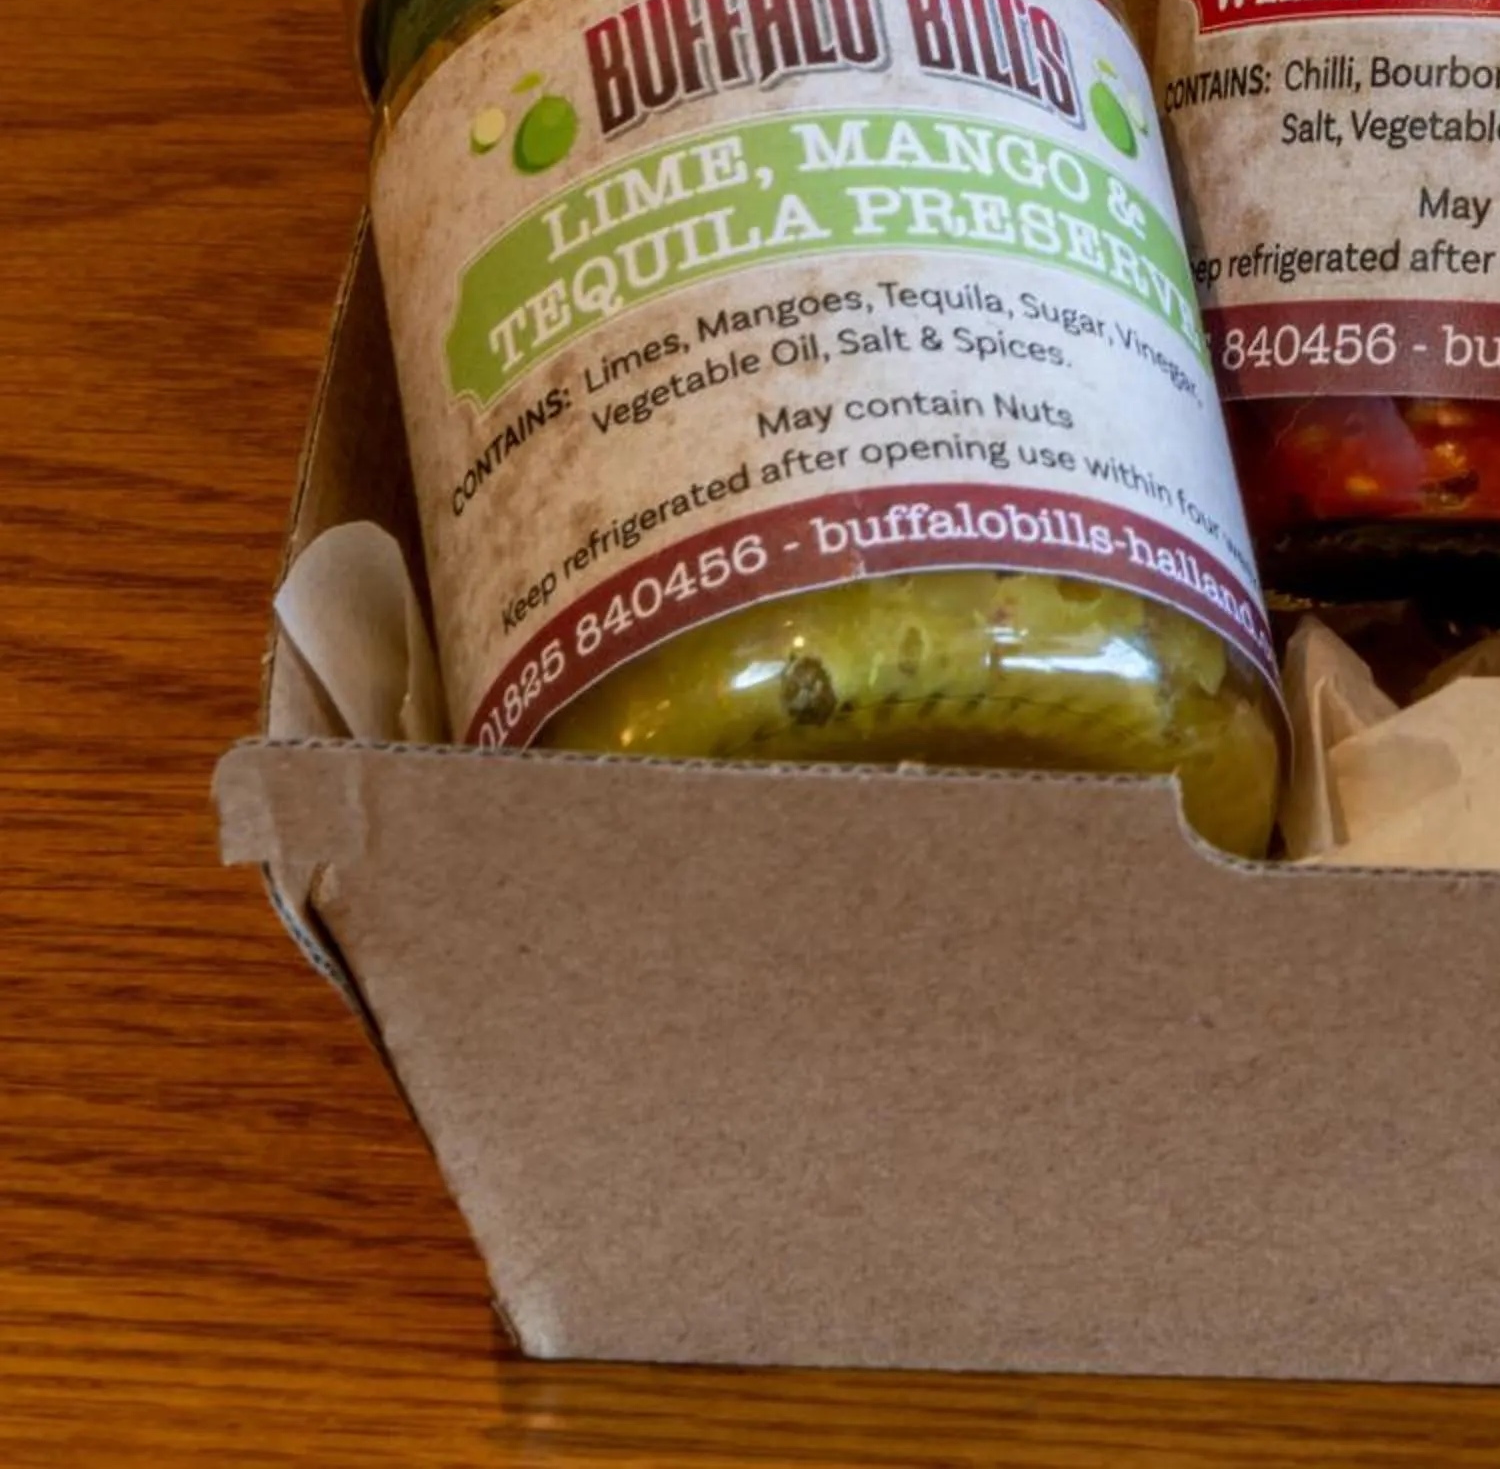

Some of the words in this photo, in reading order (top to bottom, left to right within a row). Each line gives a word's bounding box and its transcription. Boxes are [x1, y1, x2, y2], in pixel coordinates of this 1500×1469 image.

[1164, 64, 1272, 113] CONTAINS:
[1284, 57, 1363, 94] Chilli,
[1282, 112, 1345, 146] Salt,
[539, 136, 773, 263] LIME,
[792, 122, 1087, 201] MANGO
[1106, 177, 1147, 238] &
[1419, 187, 1491, 227] May
[489, 194, 831, 373] TEQUILA
[1227, 240, 1400, 283] refrigerated
[1409, 240, 1496, 276] after
[591, 349, 761, 434] Vegetable
[771, 330, 830, 367] Oil,
[837, 323, 910, 362] Salt
[919, 325, 943, 351] &
[953, 325, 1072, 367] Spices.
[1222, 323, 1397, 371] 840456
[451, 388, 572, 517] CONTAINS:
[584, 332, 690, 392] Limes,
[697, 286, 875, 341] Mangoes,
[877, 281, 1013, 320] Tequila,
[1019, 291, 1114, 349] Sugar,
[757, 404, 833, 439] May
[844, 392, 982, 423] contain
[994, 392, 1074, 428] Nuts
[502, 569, 556, 634] Keep
[563, 462, 750, 578] refrigerated
[762, 441, 847, 486] after
[861, 435, 1007, 469] opening
[1019, 437, 1077, 470] use
[1085, 452, 1173, 508] within
[478, 638, 566, 754] 01825
[575, 532, 769, 656] 840456
